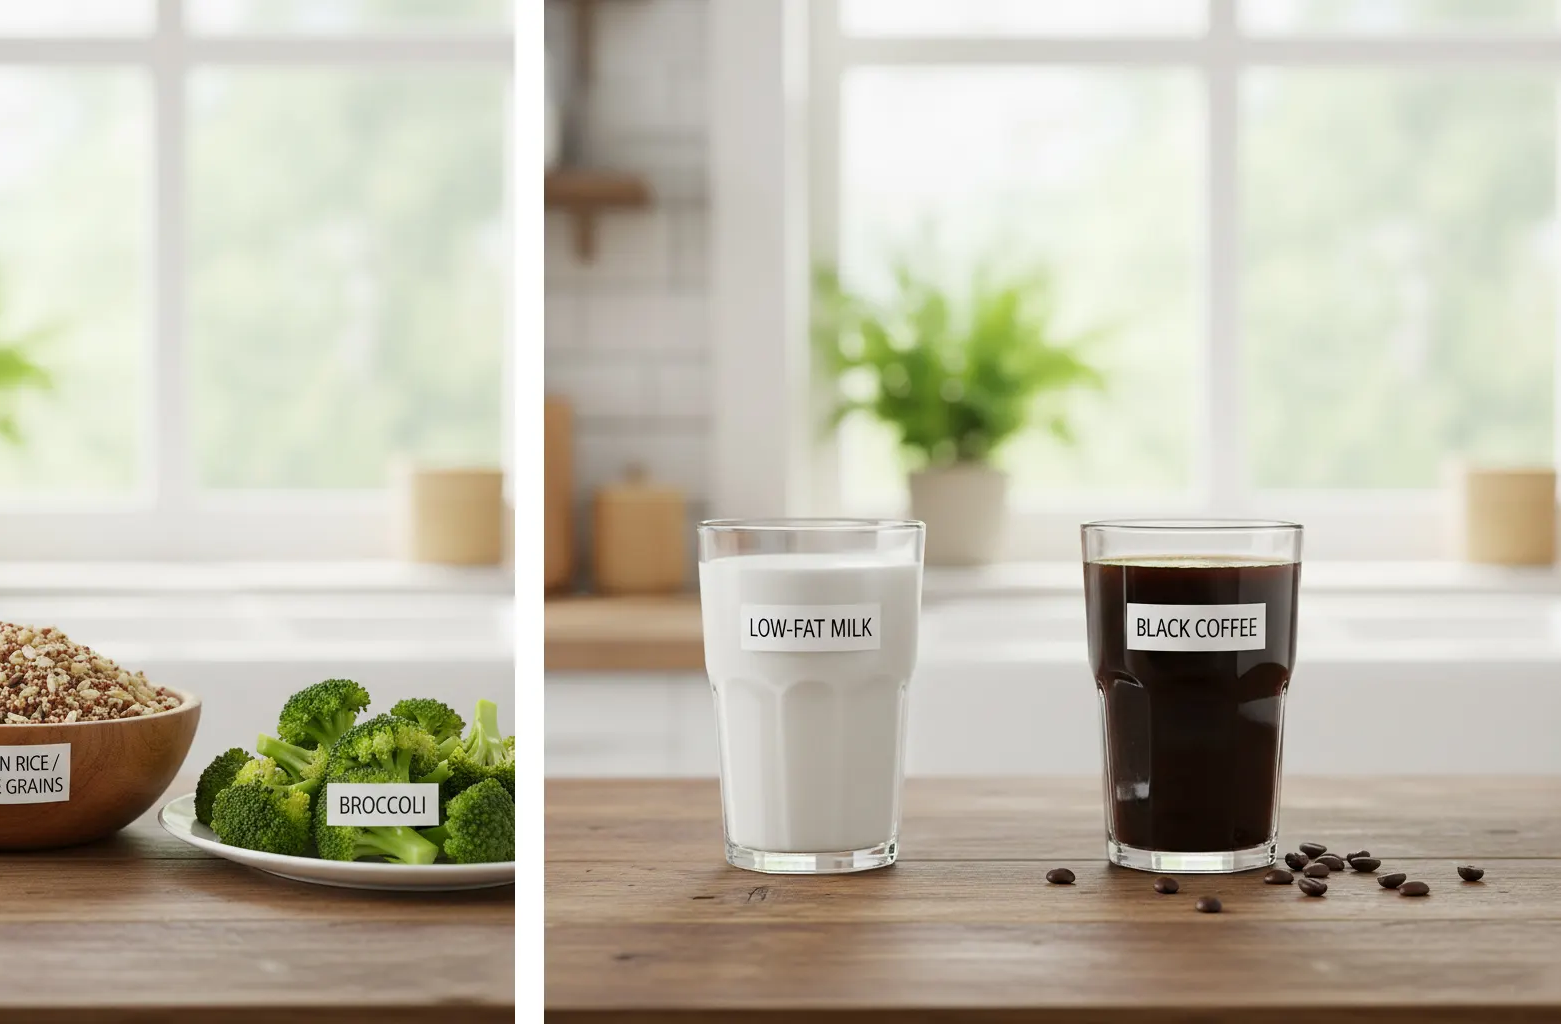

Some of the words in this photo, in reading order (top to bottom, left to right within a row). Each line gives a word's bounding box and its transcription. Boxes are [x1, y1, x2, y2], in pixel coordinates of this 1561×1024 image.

[750, 618, 825, 638] LOW-FAT
[831, 617, 872, 638] MILK
[1137, 617, 1190, 638] BLACK
[1195, 617, 1257, 638] COFFEE
[16, 754, 49, 772] RICE
[52, 753, 60, 772] /
[6, 776, 63, 795] GRAINS
[340, 795, 425, 815] BROCCOLI
